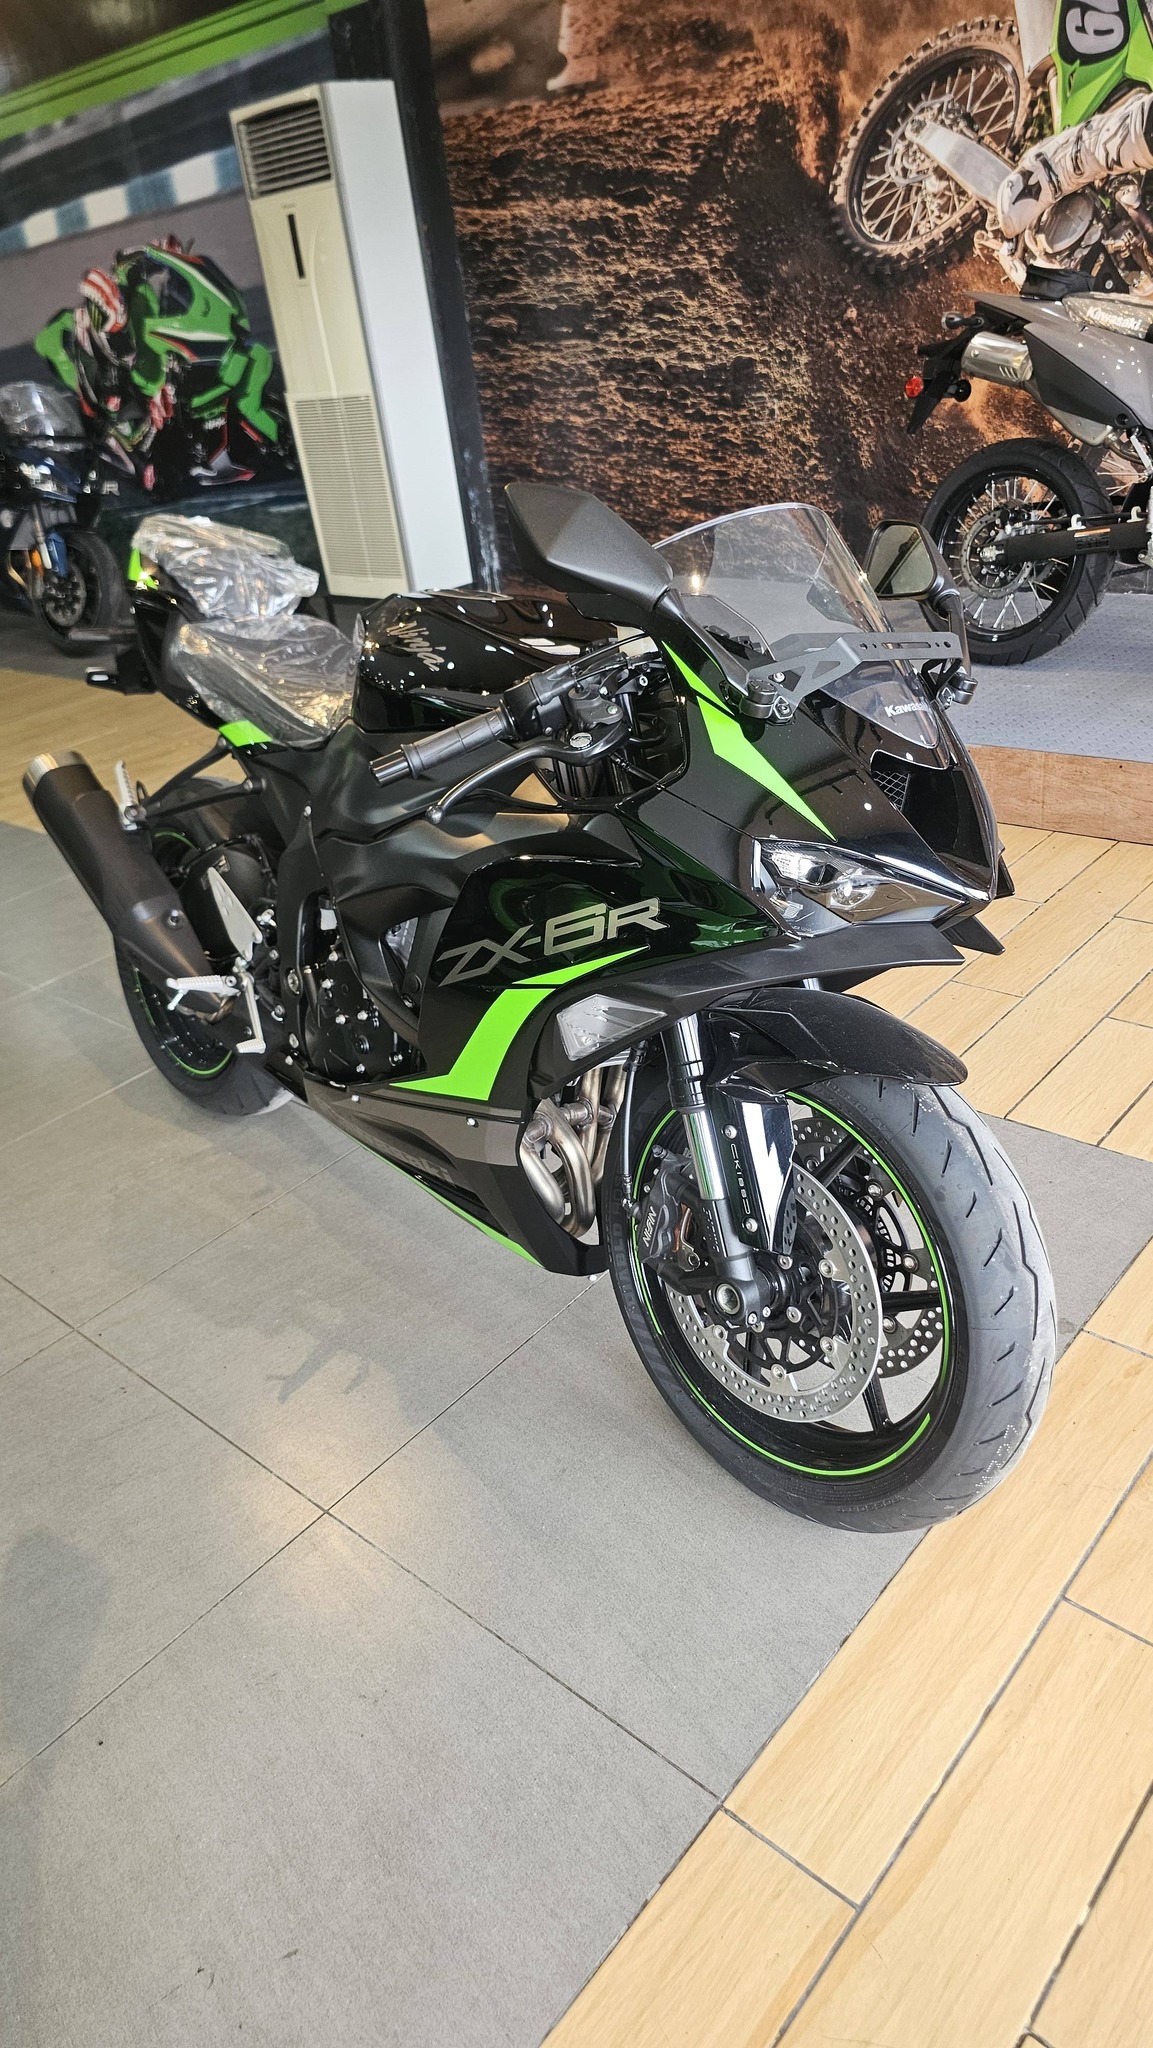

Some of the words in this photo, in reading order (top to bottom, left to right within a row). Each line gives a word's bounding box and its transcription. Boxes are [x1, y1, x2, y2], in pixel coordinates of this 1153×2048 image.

[1065, 0, 1124, 54] 6
[386, 621, 447, 672] Ninja
[436, 897, 670, 987] ZX-6R
